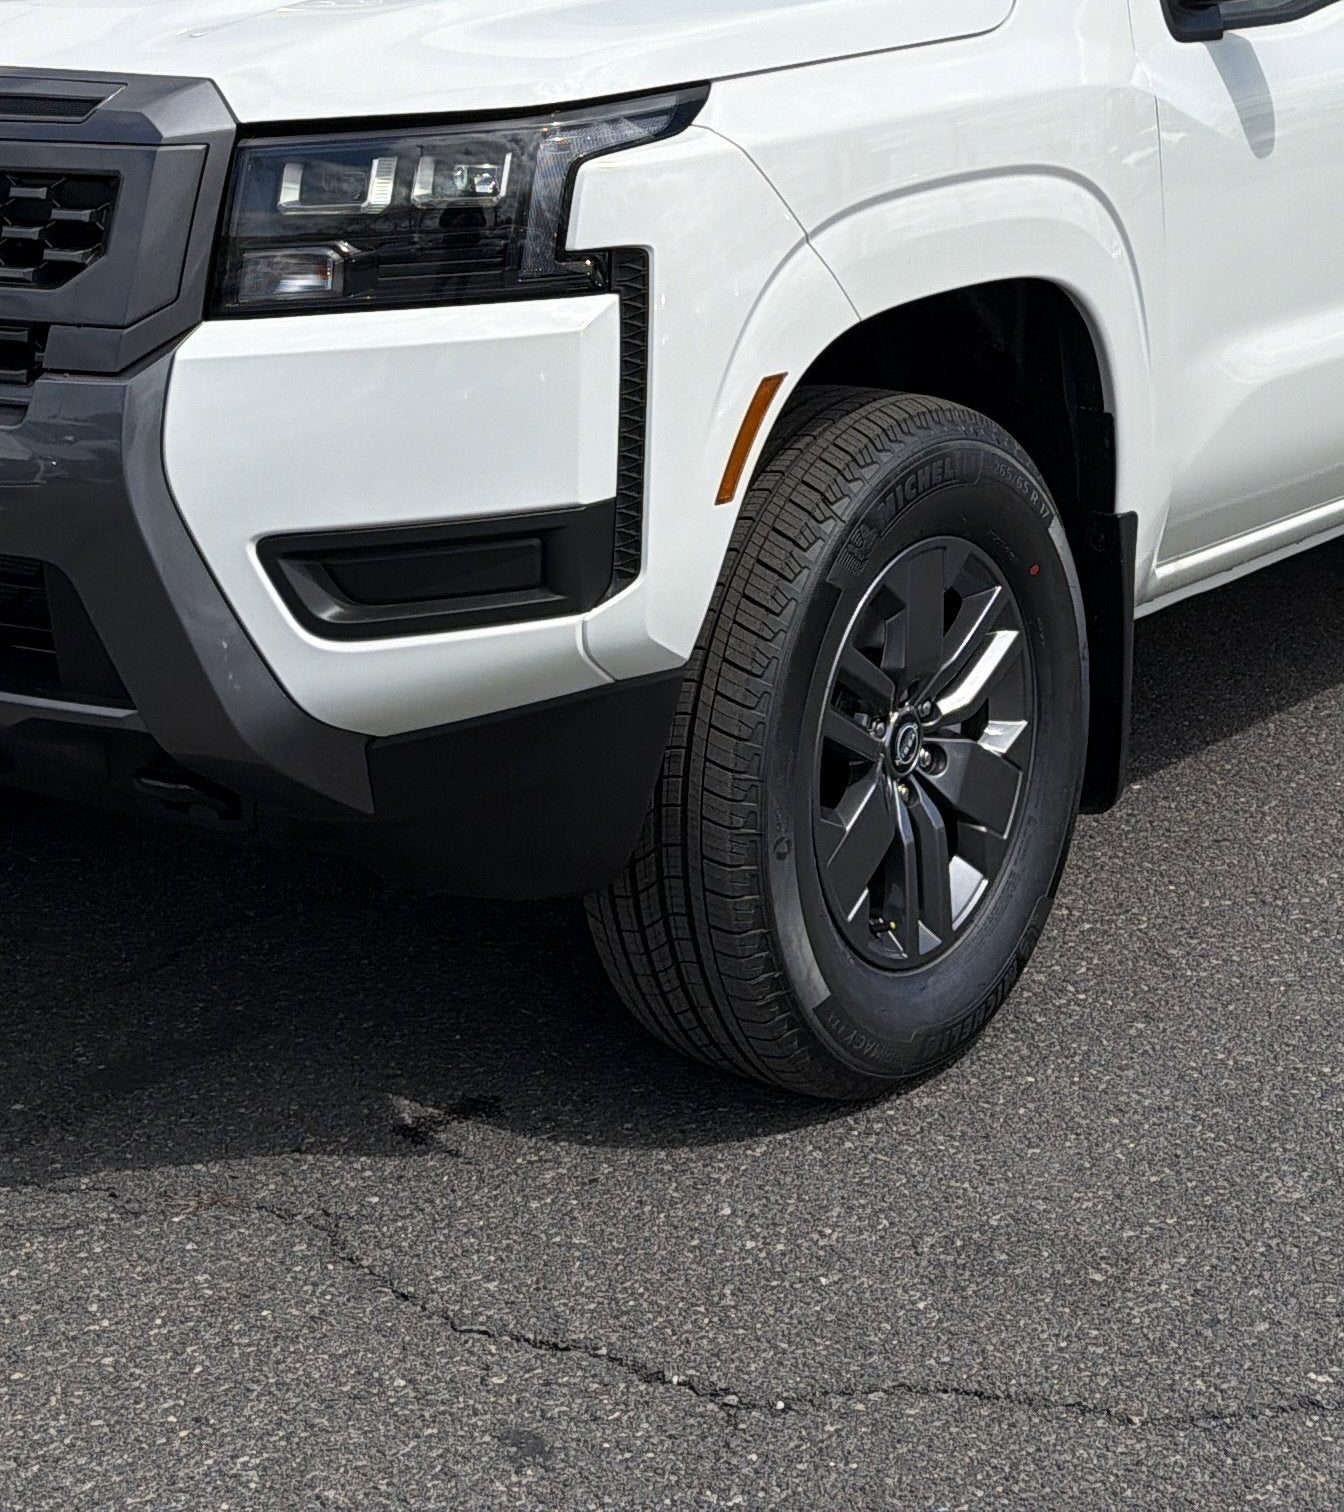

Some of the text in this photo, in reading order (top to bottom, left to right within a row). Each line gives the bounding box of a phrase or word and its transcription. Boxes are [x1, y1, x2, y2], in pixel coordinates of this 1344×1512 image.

[877, 454, 982, 524] MICHELIN
[993, 461, 1051, 518] 265/65 R 17
